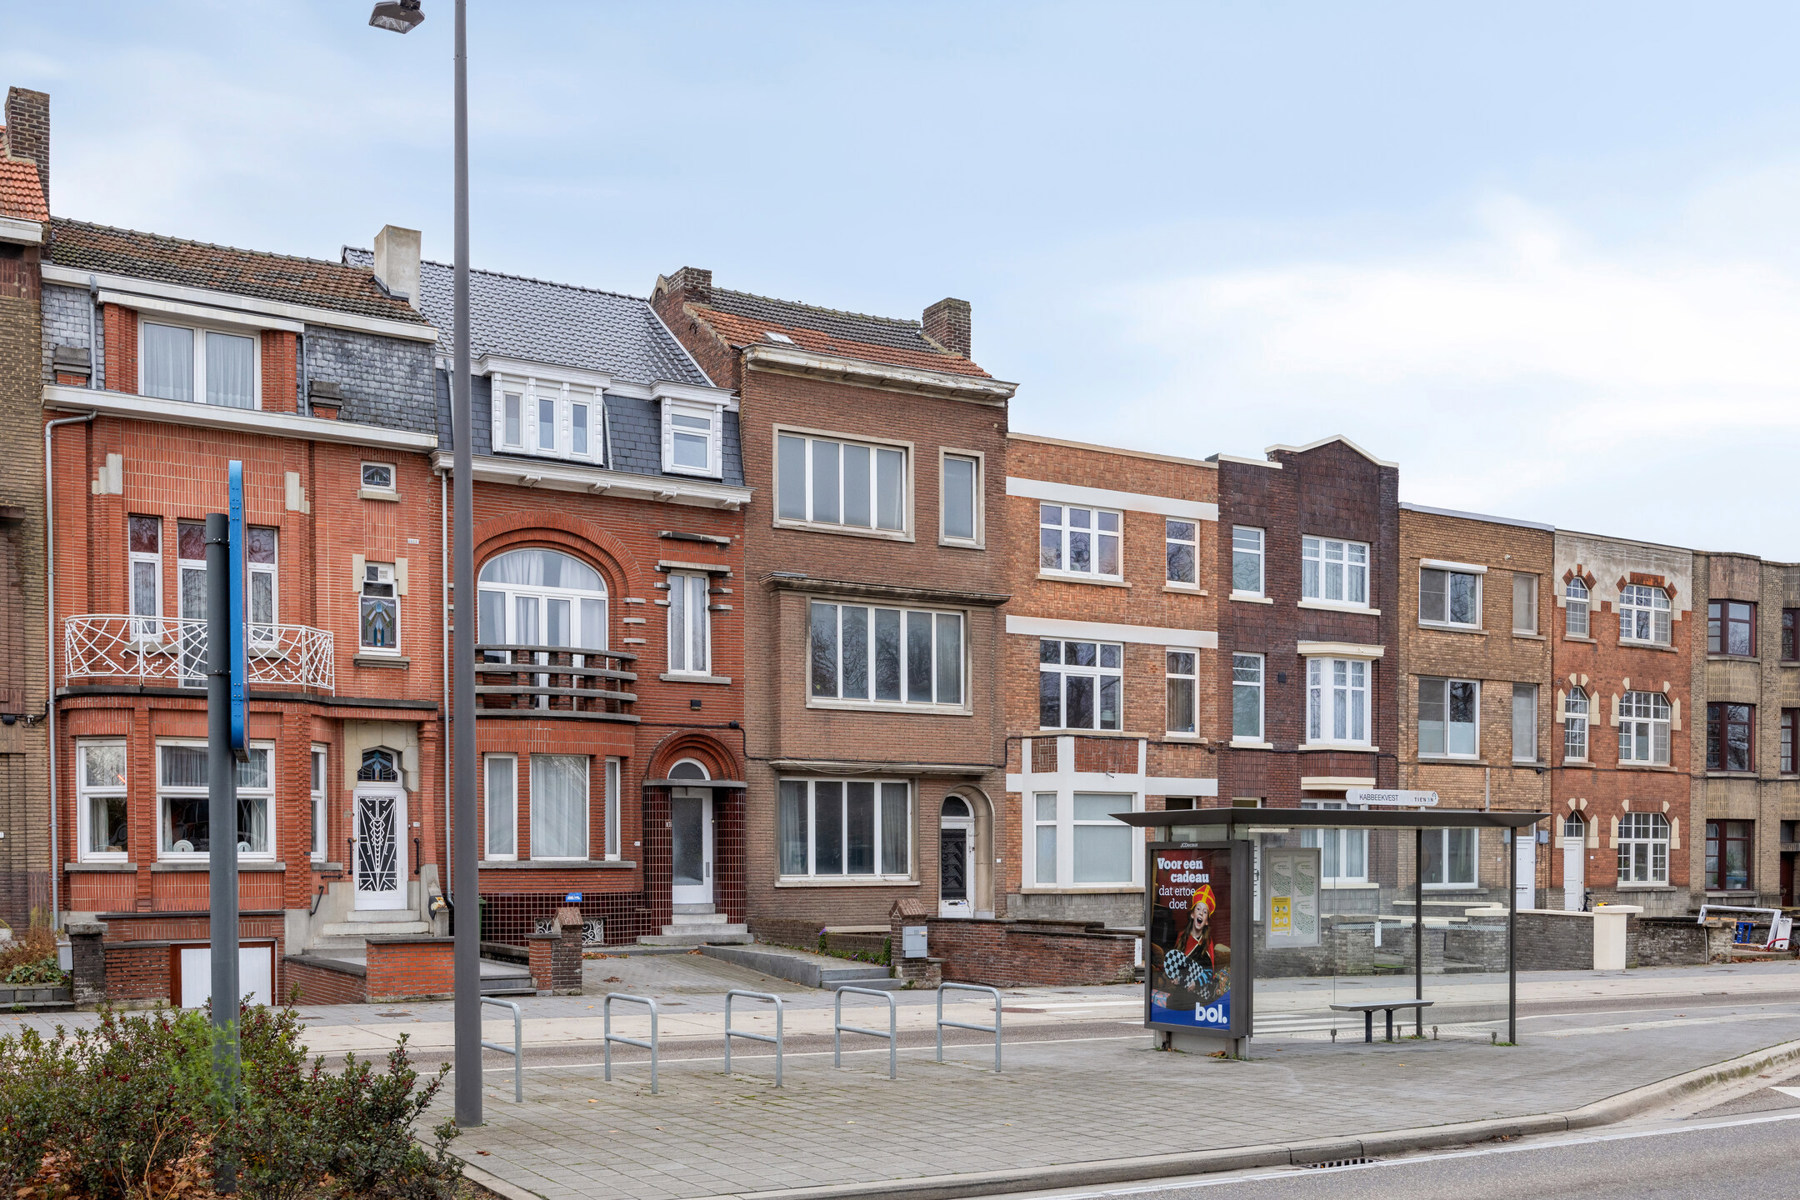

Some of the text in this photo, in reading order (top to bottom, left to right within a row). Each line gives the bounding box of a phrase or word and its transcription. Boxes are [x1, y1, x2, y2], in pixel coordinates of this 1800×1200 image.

[1359, 793, 1399, 802] KABBEEKVEST
[1157, 857, 1203, 869] Voor een
[1170, 870, 1209, 883] cadeau
[1158, 885, 1195, 896] dat ertoe
[1169, 898, 1188, 909] doet
[1195, 1002, 1228, 1024] bol.
